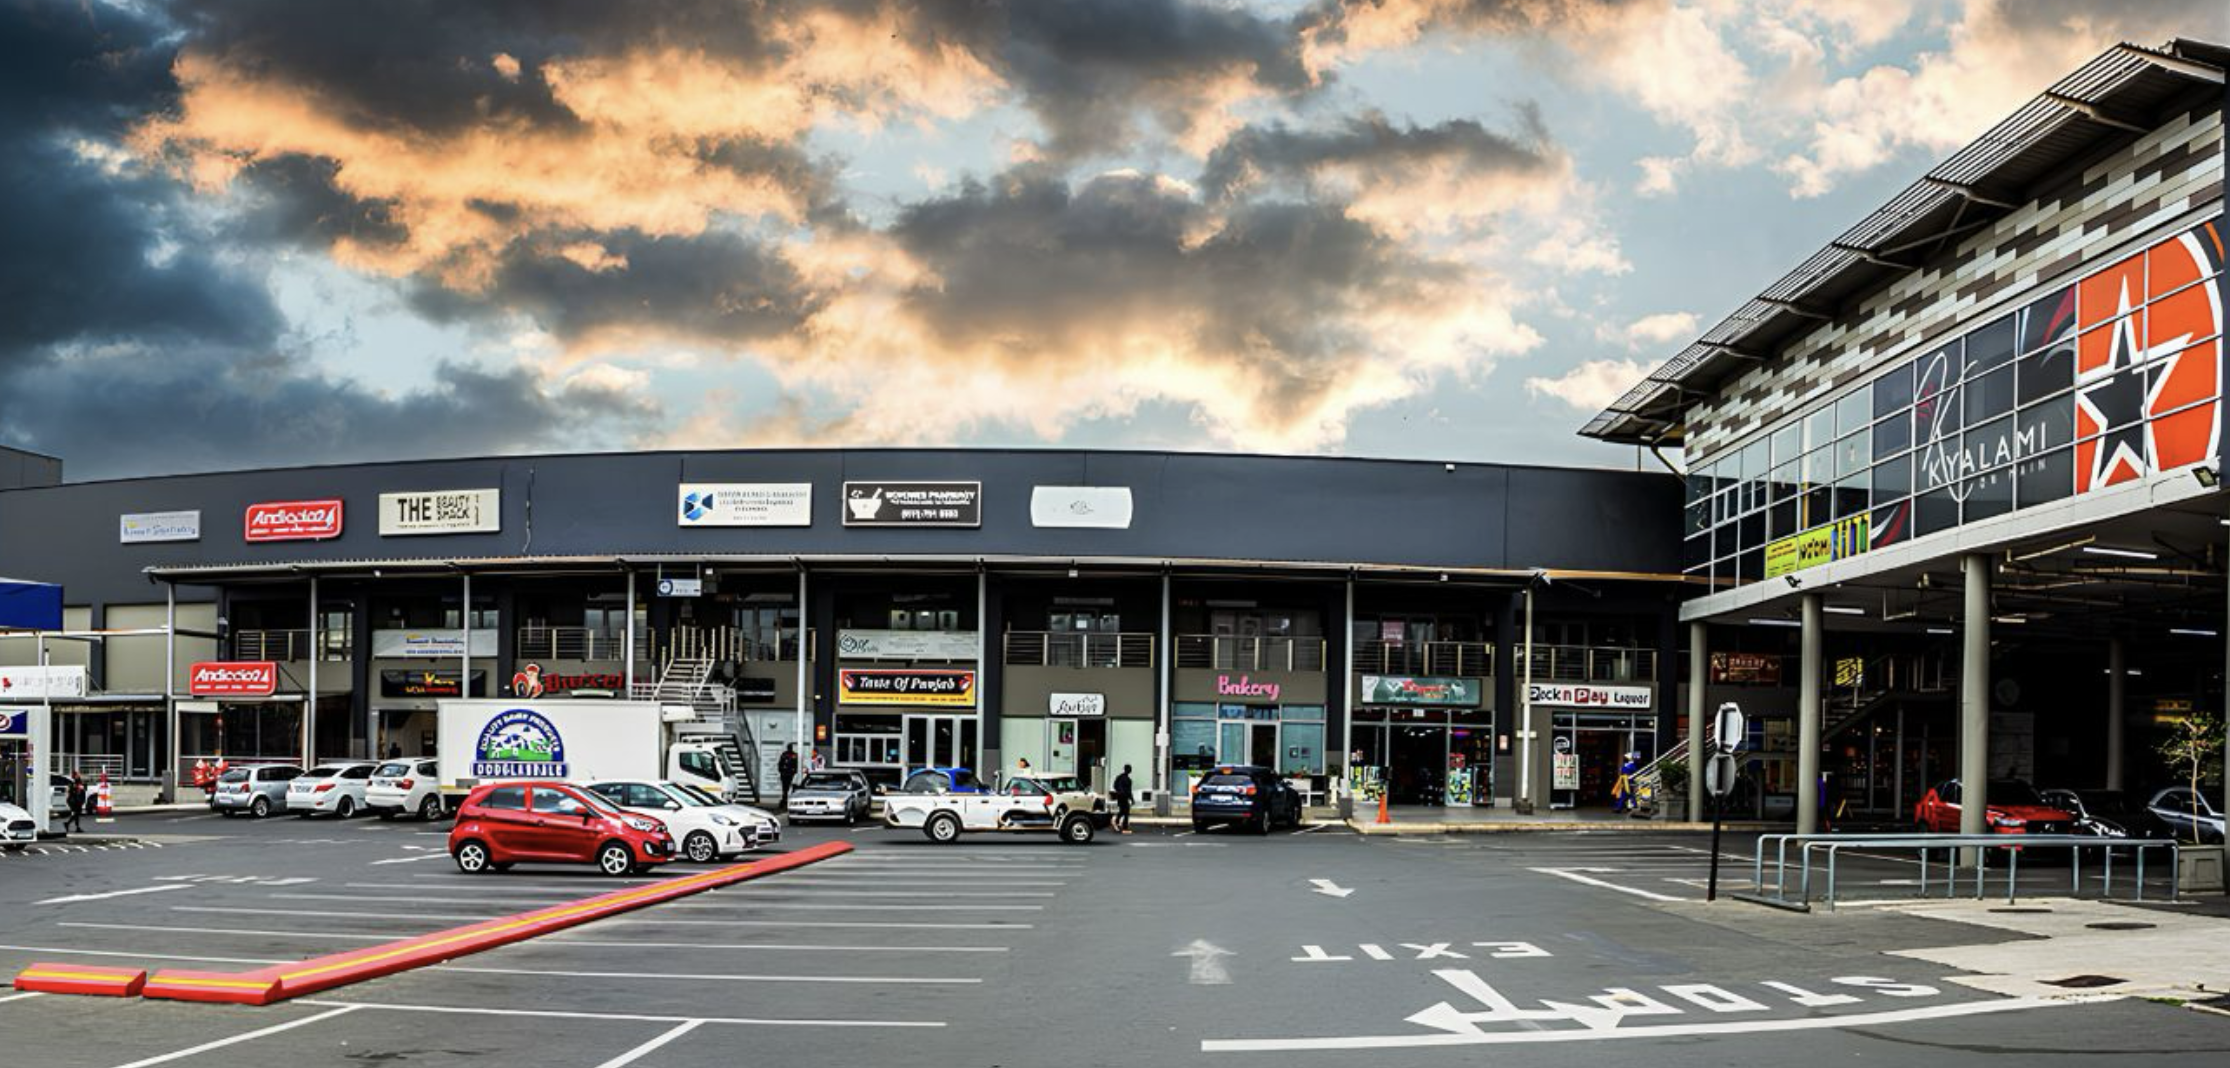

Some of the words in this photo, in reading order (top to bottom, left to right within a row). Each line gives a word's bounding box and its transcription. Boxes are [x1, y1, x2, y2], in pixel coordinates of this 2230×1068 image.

[1928, 422, 2046, 488] KYALAMI
[398, 497, 431, 522] THE
[1219, 675, 1280, 701] Bakery
[1291, 941, 1554, 961] EXIT
[1588, 976, 1941, 1014] STOP
